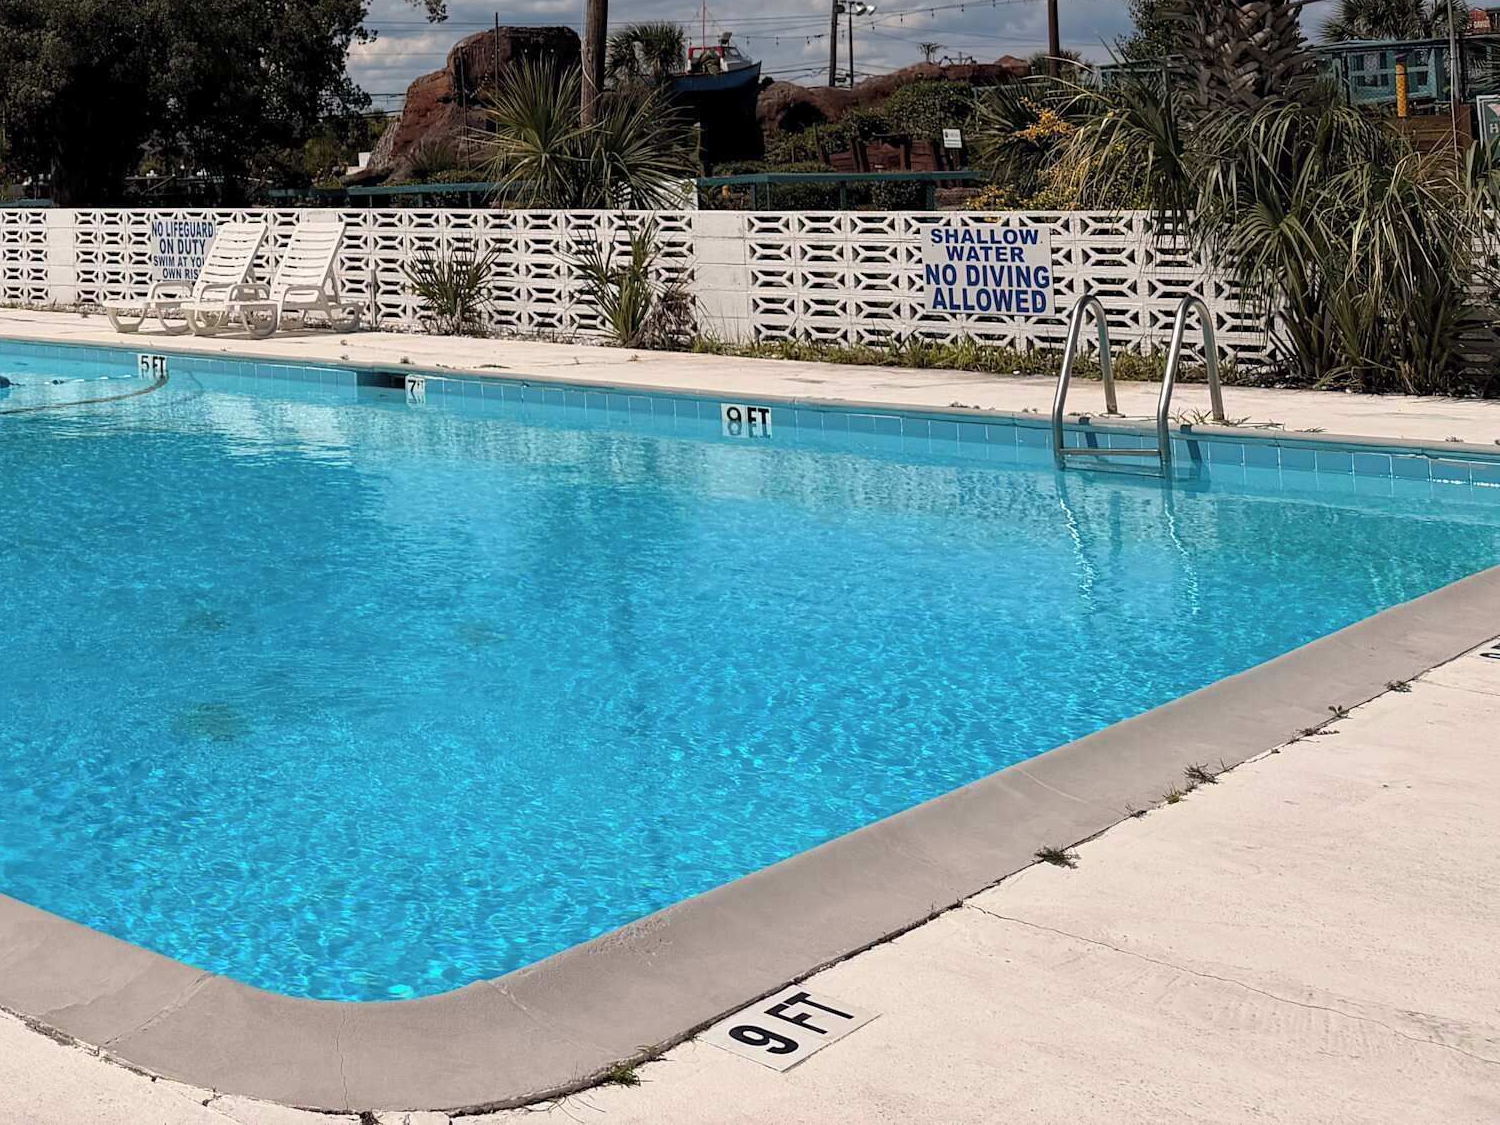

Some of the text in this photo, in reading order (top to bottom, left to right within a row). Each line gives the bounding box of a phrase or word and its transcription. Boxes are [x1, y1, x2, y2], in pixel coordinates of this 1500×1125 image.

[151, 221, 214, 238] NO LIFEGUARD
[931, 228, 1039, 245] SHALLOW
[159, 238, 206, 255] ON DUTY
[946, 245, 1025, 262] WATER
[153, 255, 205, 268] SWIM AT YO
[162, 268, 202, 280] OWN RIS
[925, 264, 1050, 289] NO DIVING
[932, 287, 1047, 314] ALLOWED
[141, 355, 165, 375] 5 FT
[407, 379, 416, 394] 7
[747, 406, 770, 428] FT
[728, 991, 855, 1055] 9 FT
